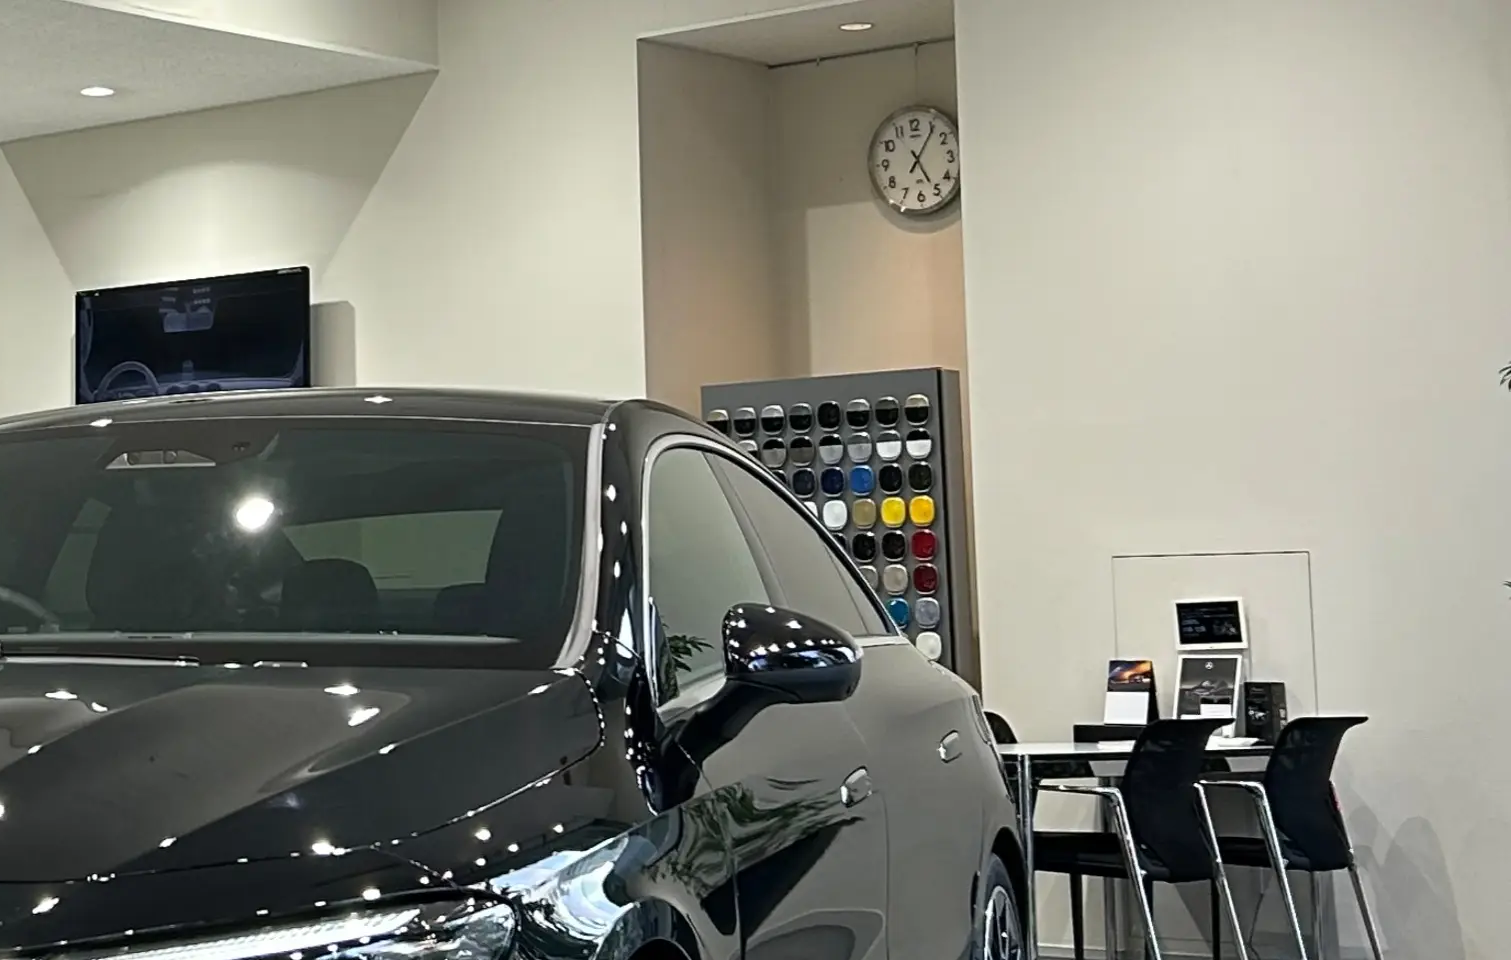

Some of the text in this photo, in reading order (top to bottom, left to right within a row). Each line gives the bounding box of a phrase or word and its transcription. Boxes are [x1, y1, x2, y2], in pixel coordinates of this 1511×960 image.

[909, 118, 921, 132] 12
[895, 126, 904, 138] 11
[939, 132, 948, 145] 2
[884, 140, 896, 152] 10
[947, 151, 955, 163] 3
[881, 159, 890, 172] 9
[943, 169, 951, 181] 4
[888, 176, 896, 188] 8
[901, 187, 909, 199] 7
[933, 184, 942, 196] 5
[917, 191, 926, 202] 6
